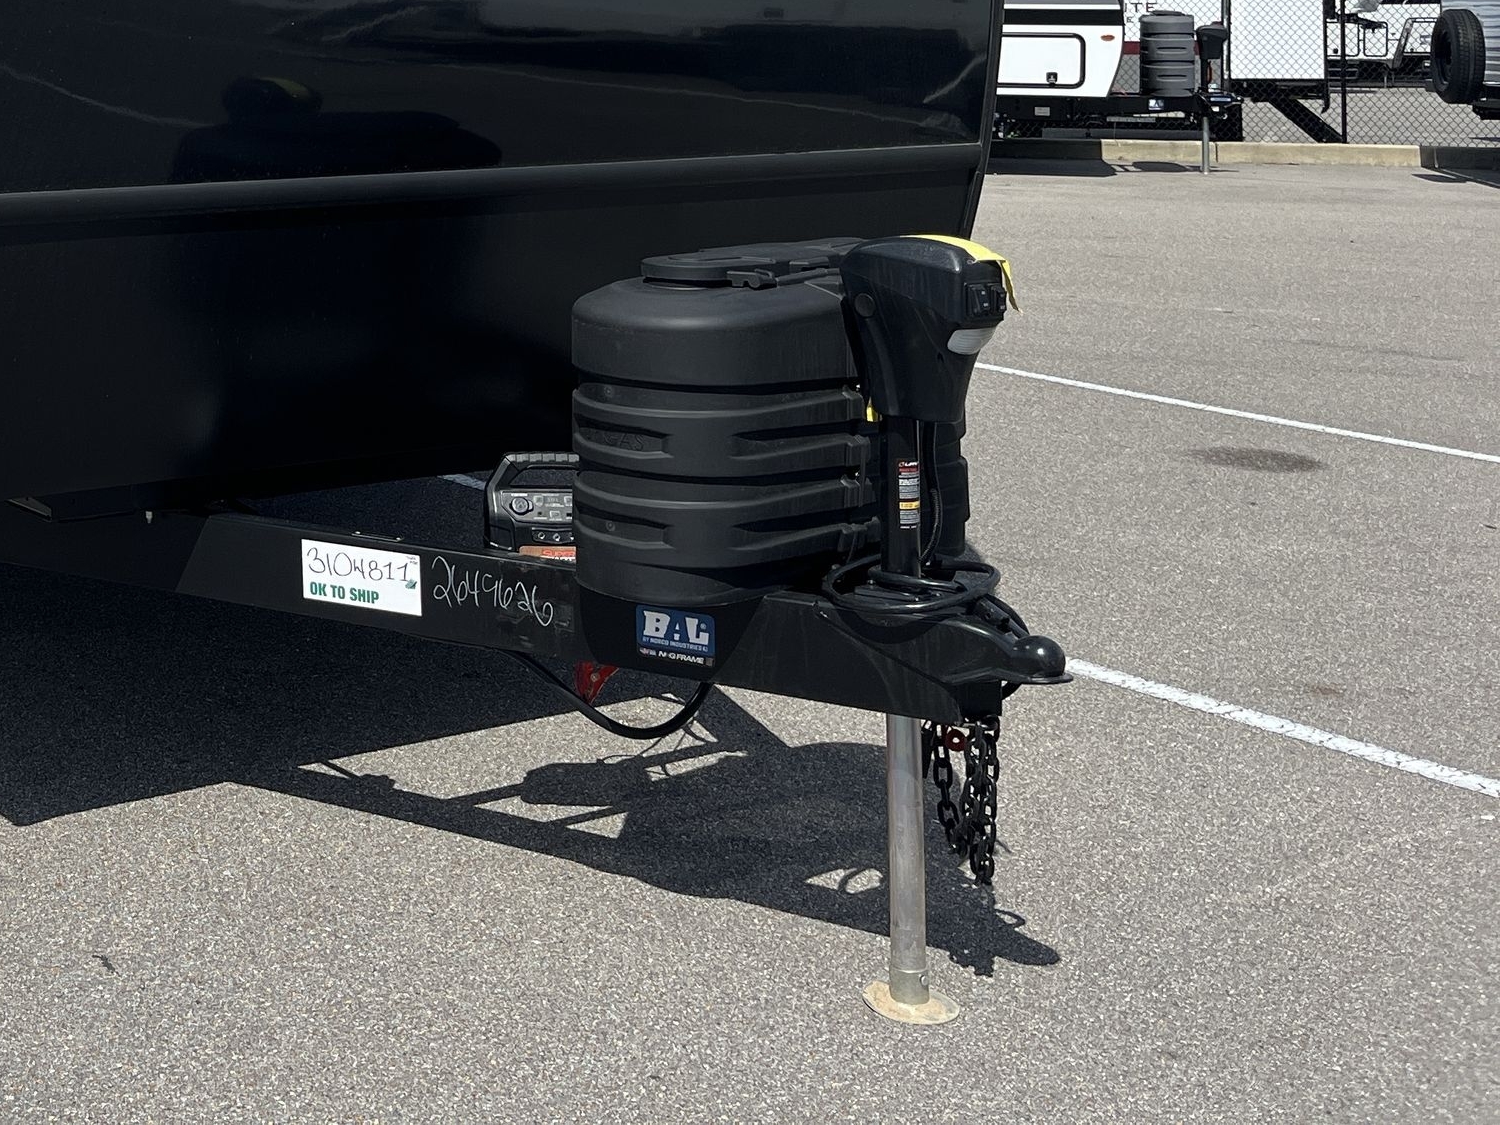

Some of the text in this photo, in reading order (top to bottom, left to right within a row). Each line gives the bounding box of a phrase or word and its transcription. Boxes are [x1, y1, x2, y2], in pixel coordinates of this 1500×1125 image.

[306, 547, 409, 582] 3104811
[309, 581, 380, 604] OK TO SHIP
[431, 555, 554, 627] 2649626
